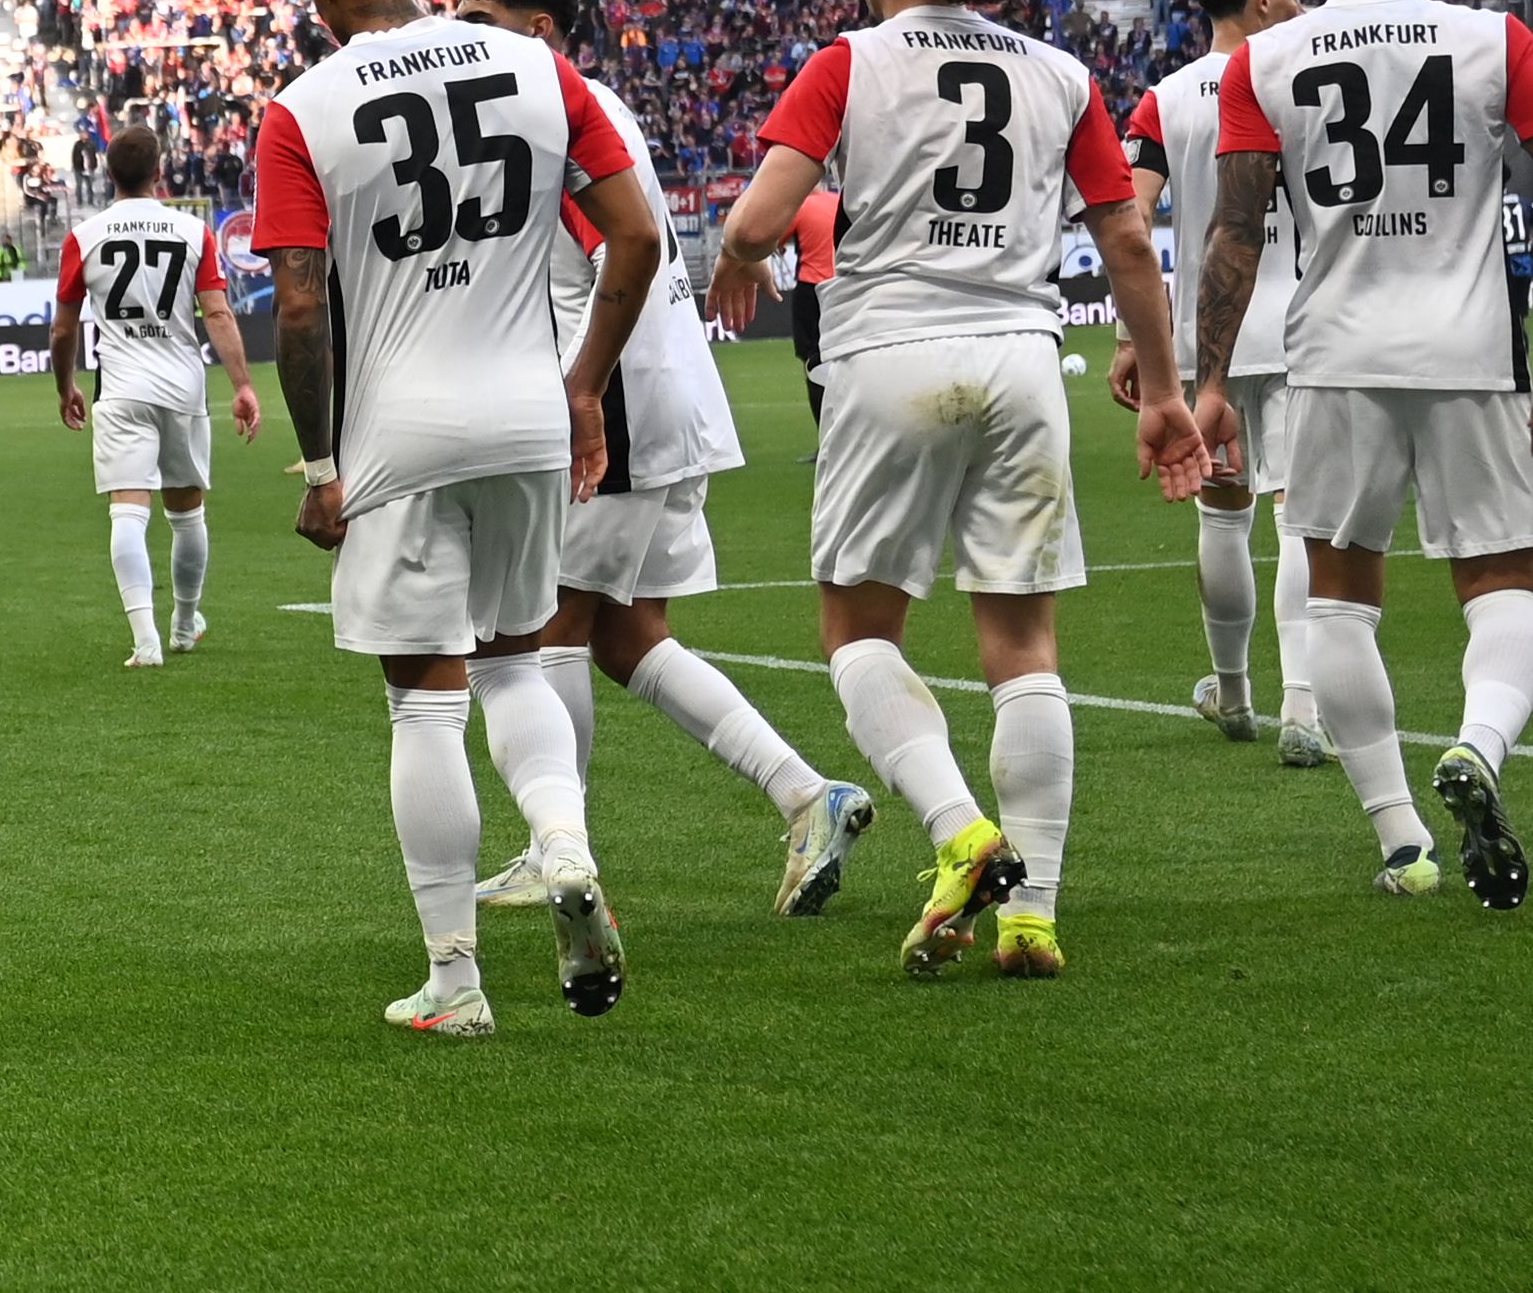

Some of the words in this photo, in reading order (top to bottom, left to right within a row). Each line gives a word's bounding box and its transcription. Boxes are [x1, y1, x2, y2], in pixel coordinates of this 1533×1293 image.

[903, 31, 1029, 56] FRANKFURT
[1312, 24, 1438, 56] FRANKFURT
[356, 41, 491, 86] FRANKFURT
[934, 61, 1013, 214] 3
[1292, 55, 1465, 208] 34
[353, 72, 532, 261] 35
[107, 221, 175, 235] FRANKFURT
[928, 220, 1006, 249] THEATE
[1353, 212, 1428, 238] COLLINS
[100, 240, 187, 320] 27
[425, 259, 470, 293] TUTA
[140, 324, 173, 339] GÖTZ
